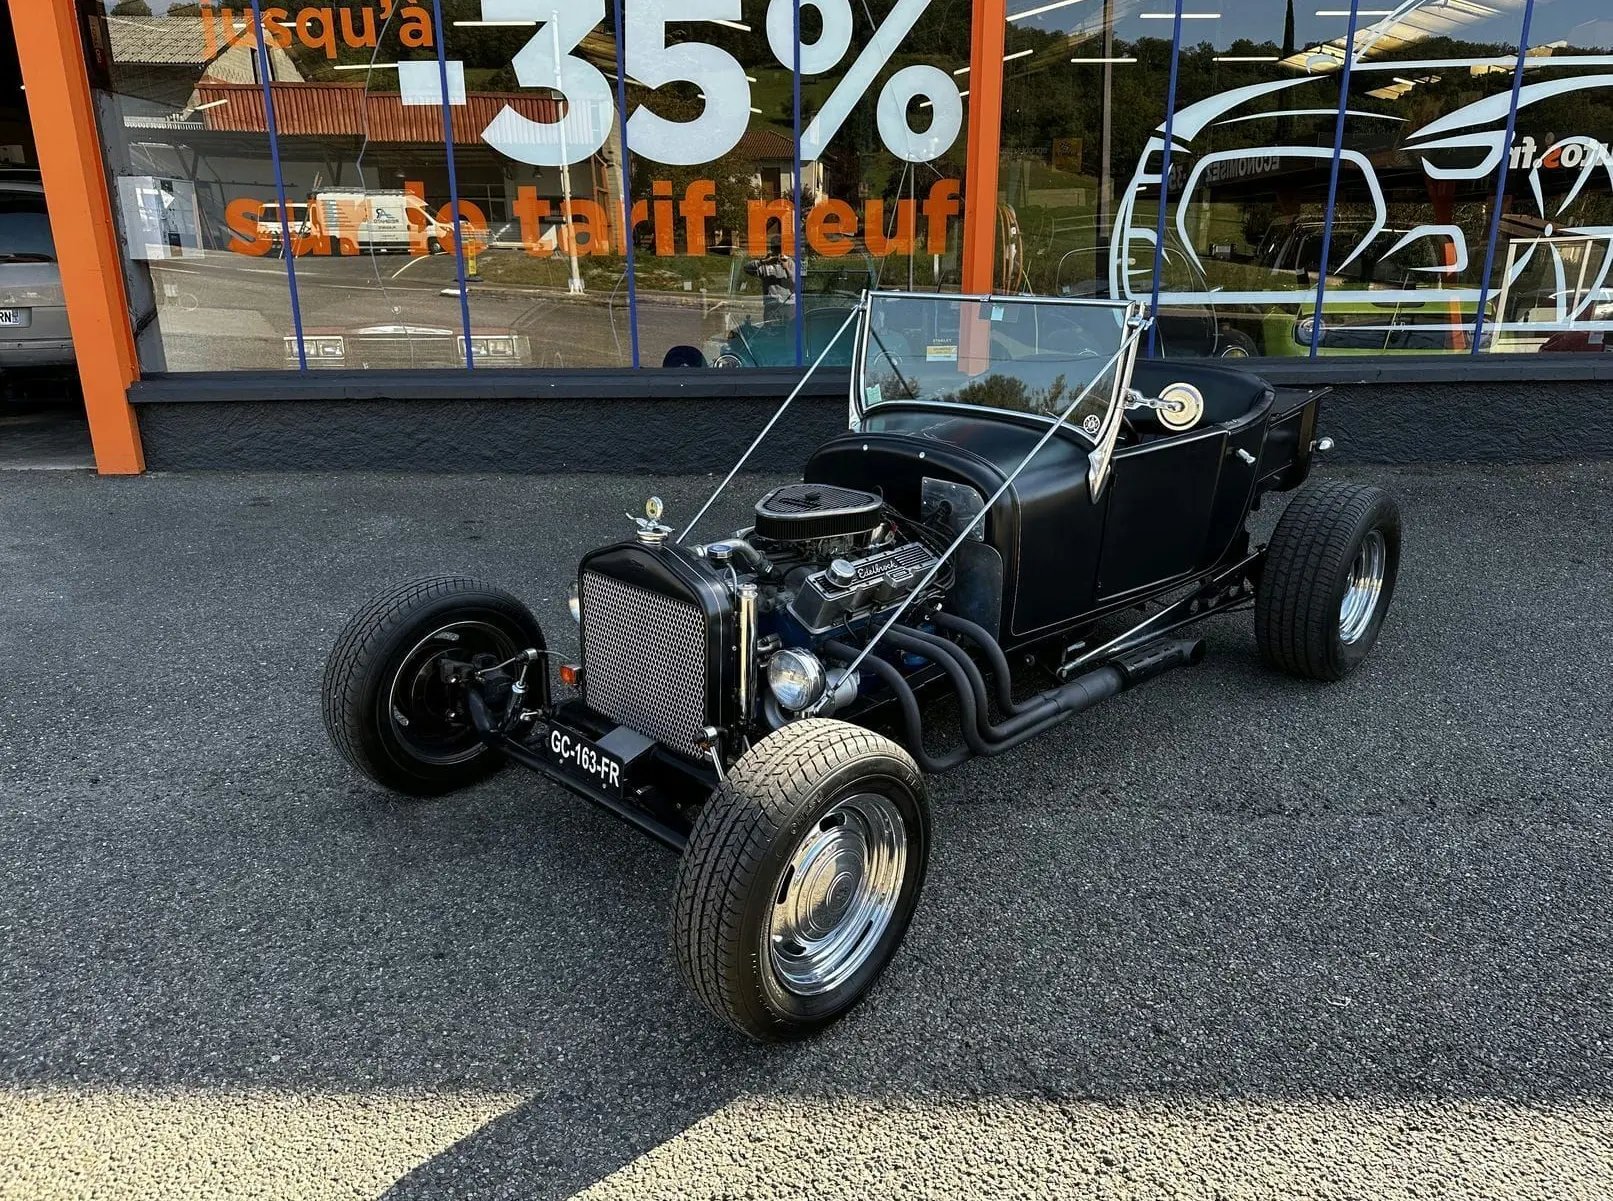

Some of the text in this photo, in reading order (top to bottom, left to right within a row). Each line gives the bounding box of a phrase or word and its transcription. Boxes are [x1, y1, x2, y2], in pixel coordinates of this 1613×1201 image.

[513, 180, 716, 257] tarif
[748, 179, 961, 257] neuf
[857, 560, 898, 579] Edelbrock
[551, 730, 619, 788] GC-163-FR
